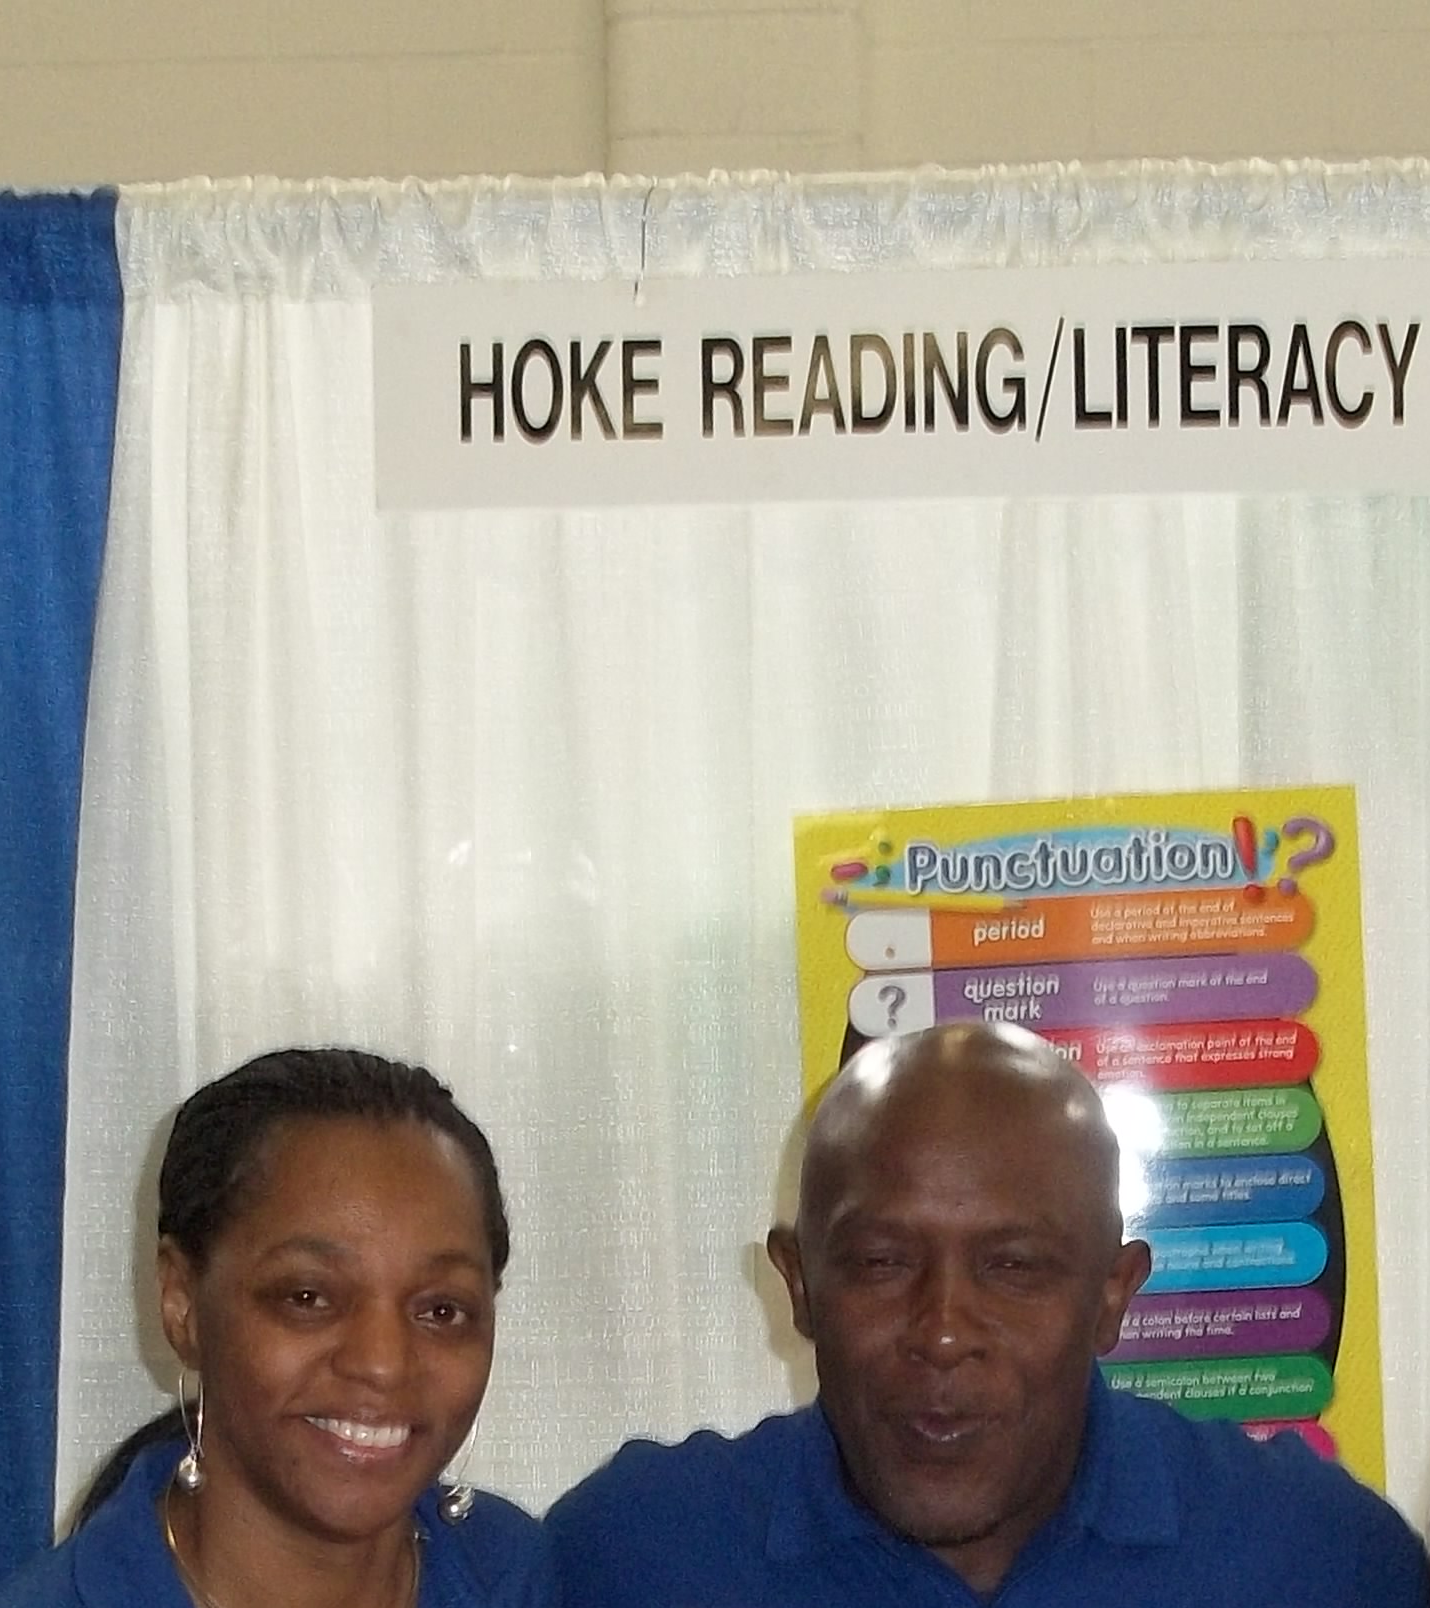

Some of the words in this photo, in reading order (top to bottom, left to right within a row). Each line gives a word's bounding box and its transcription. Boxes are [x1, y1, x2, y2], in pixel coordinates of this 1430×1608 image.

[459, 338, 661, 442] HOKE
[700, 316, 1419, 441] READING/LITERACY
[973, 918, 1044, 946] period
[964, 977, 1059, 1003] question
[984, 1001, 1042, 1021] mark
[1142, 1312, 1171, 1327] colon
[1175, 1310, 1210, 1324] before
[1214, 1308, 1251, 1322] certain
[1255, 1305, 1276, 1320] lists
[1280, 1305, 1300, 1319] and
